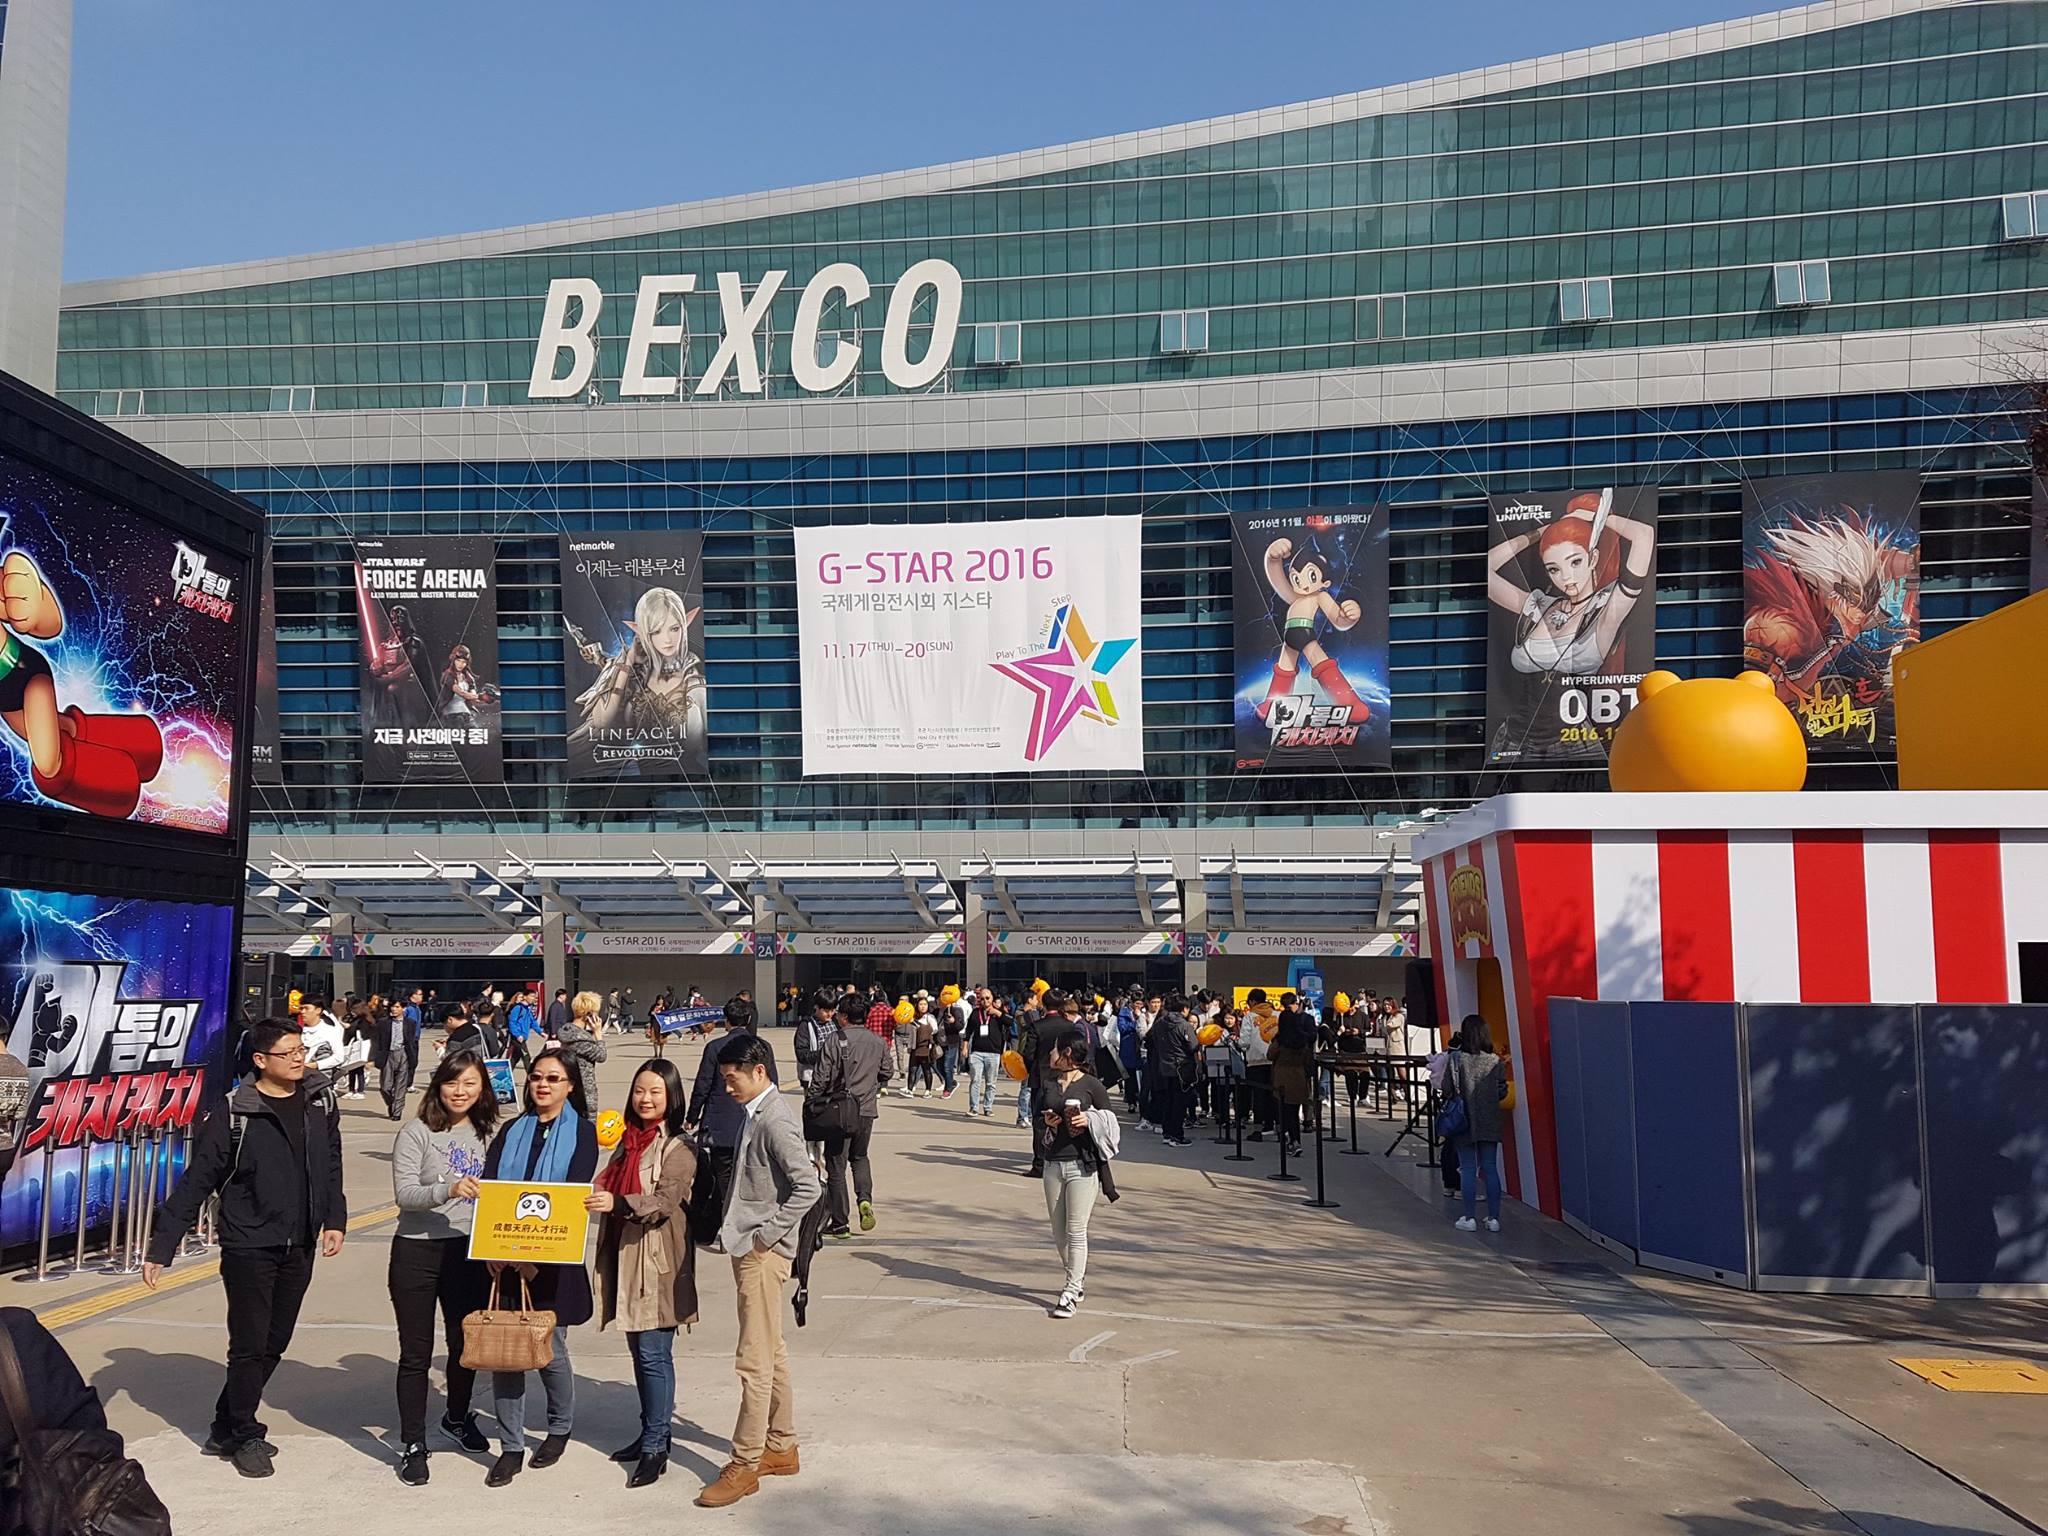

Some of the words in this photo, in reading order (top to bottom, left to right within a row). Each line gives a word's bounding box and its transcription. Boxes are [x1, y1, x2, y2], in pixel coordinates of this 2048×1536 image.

[528, 258, 963, 398] BEXCO
[1505, 503, 1543, 514] HYPER
[1249, 519, 1280, 529] 2016년
[1282, 517, 1305, 527] 11월,
[1496, 511, 1552, 523] UNIVERSE
[569, 540, 616, 552] netmarble
[362, 558, 393, 567] STAR
[394, 558, 427, 567] WARS
[576, 559, 622, 579] 이제는
[625, 557, 686, 577] 레볼루션
[819, 552, 954, 585] G-STAR
[965, 547, 1054, 583] 2016
[363, 569, 417, 589] FORCE
[422, 569, 487, 589] ARENA
[445, 591, 457, 599] THE
[1051, 593, 1072, 608] Step
[821, 592, 936, 613] 국제게임전시회
[943, 591, 993, 611] 지스타
[1040, 614, 1052, 636] Next
[995, 649, 1015, 661] Play
[1017, 646, 1028, 655] To
[1029, 642, 1046, 652] The
[374, 728, 403, 745] 지금
[406, 728, 466, 745] 사전예약
[468, 728, 489, 745] 중!
[589, 726, 674, 741] LINEAGE
[602, 748, 673, 758] REVOLUTION
[391, 938, 428, 947] G-STAR
[430, 938, 454, 947] 2016
[602, 937, 639, 946] G-STAR
[641, 937, 665, 946] 2016
[813, 937, 849, 946] G-STAR
[852, 937, 876, 946] 2016
[1025, 936, 1063, 945] G-STAR
[1065, 936, 1090, 945] 2016
[1247, 937, 1286, 946] G-STAR
[1289, 937, 1315, 946] 2016
[338, 946, 345, 960] 1
[758, 945, 774, 957] 2A
[1188, 945, 1203, 958] 2B
[25, 1068, 205, 1149] 캐치캐치
[493, 1222, 569, 1235] 成都天府人才行动
